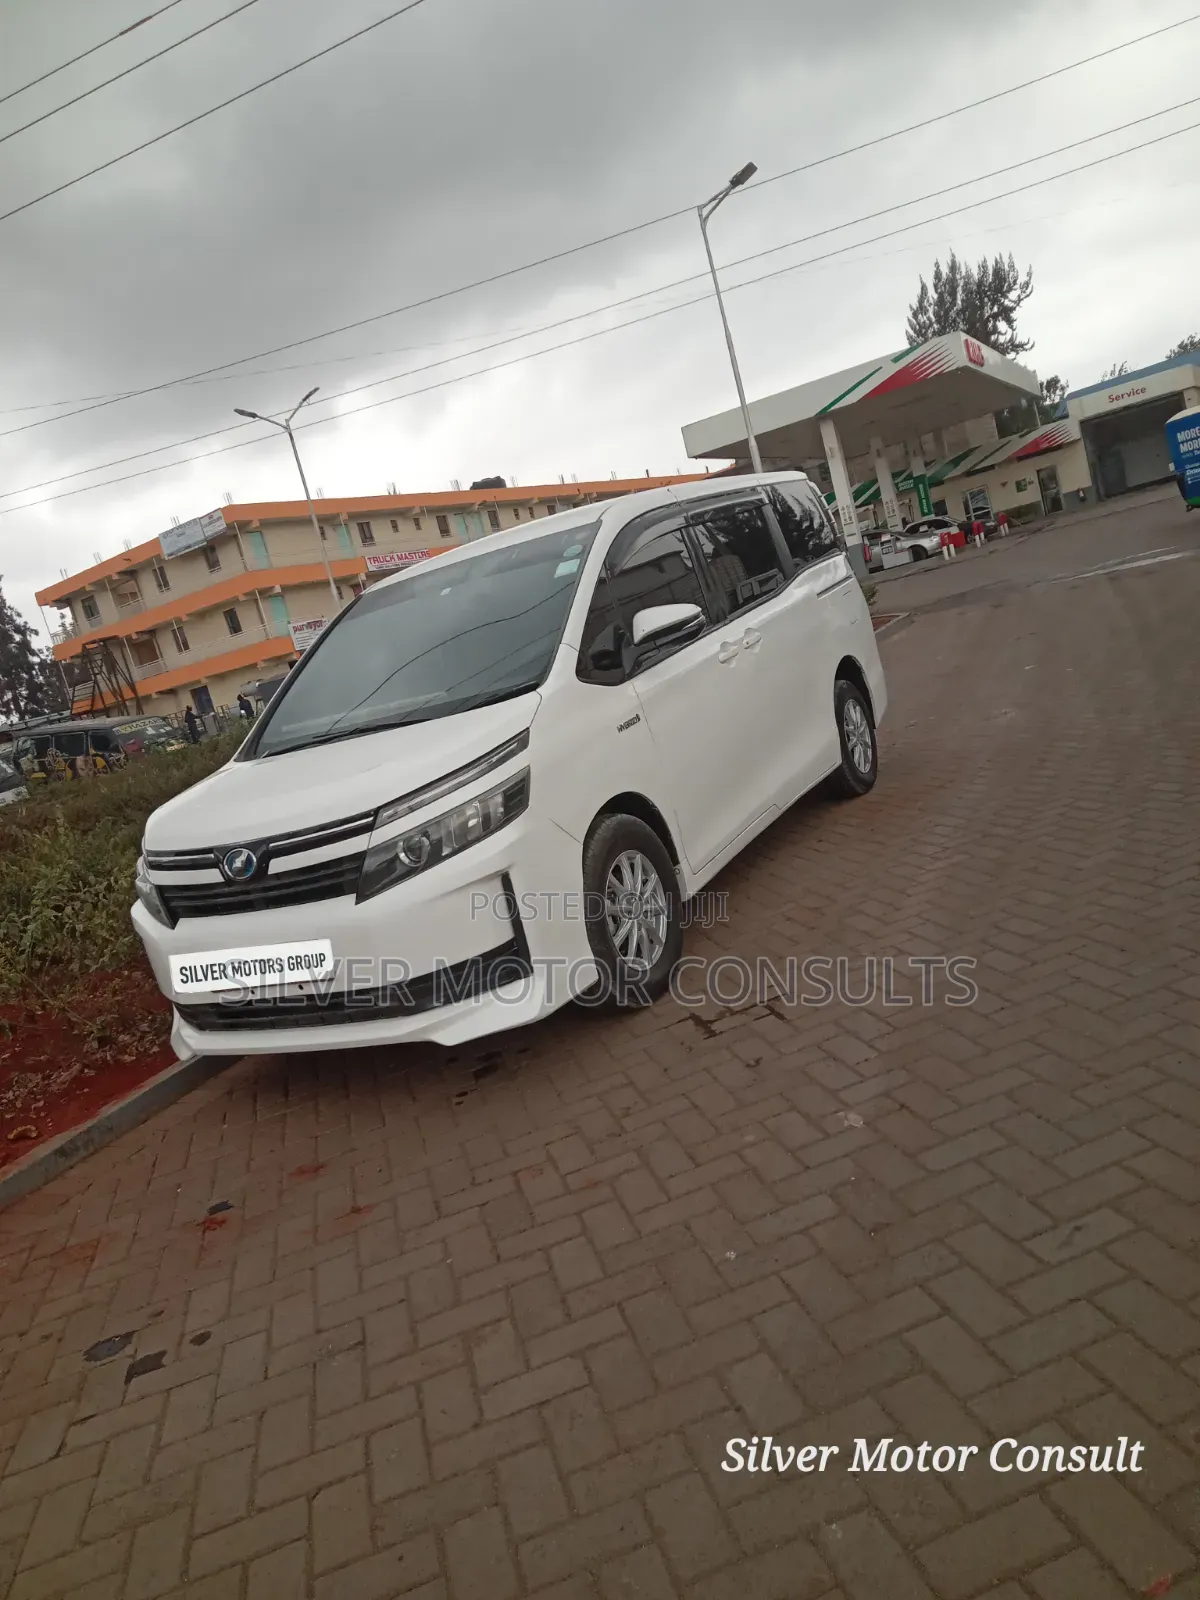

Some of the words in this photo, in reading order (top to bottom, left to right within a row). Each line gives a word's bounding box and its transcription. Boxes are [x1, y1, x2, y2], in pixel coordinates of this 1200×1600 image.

[1108, 387, 1147, 403] Service
[367, 554, 396, 565] TRUCK
[180, 962, 228, 984] SILVER
[231, 957, 284, 979] MOTORS
[287, 952, 326, 971] GROUP
